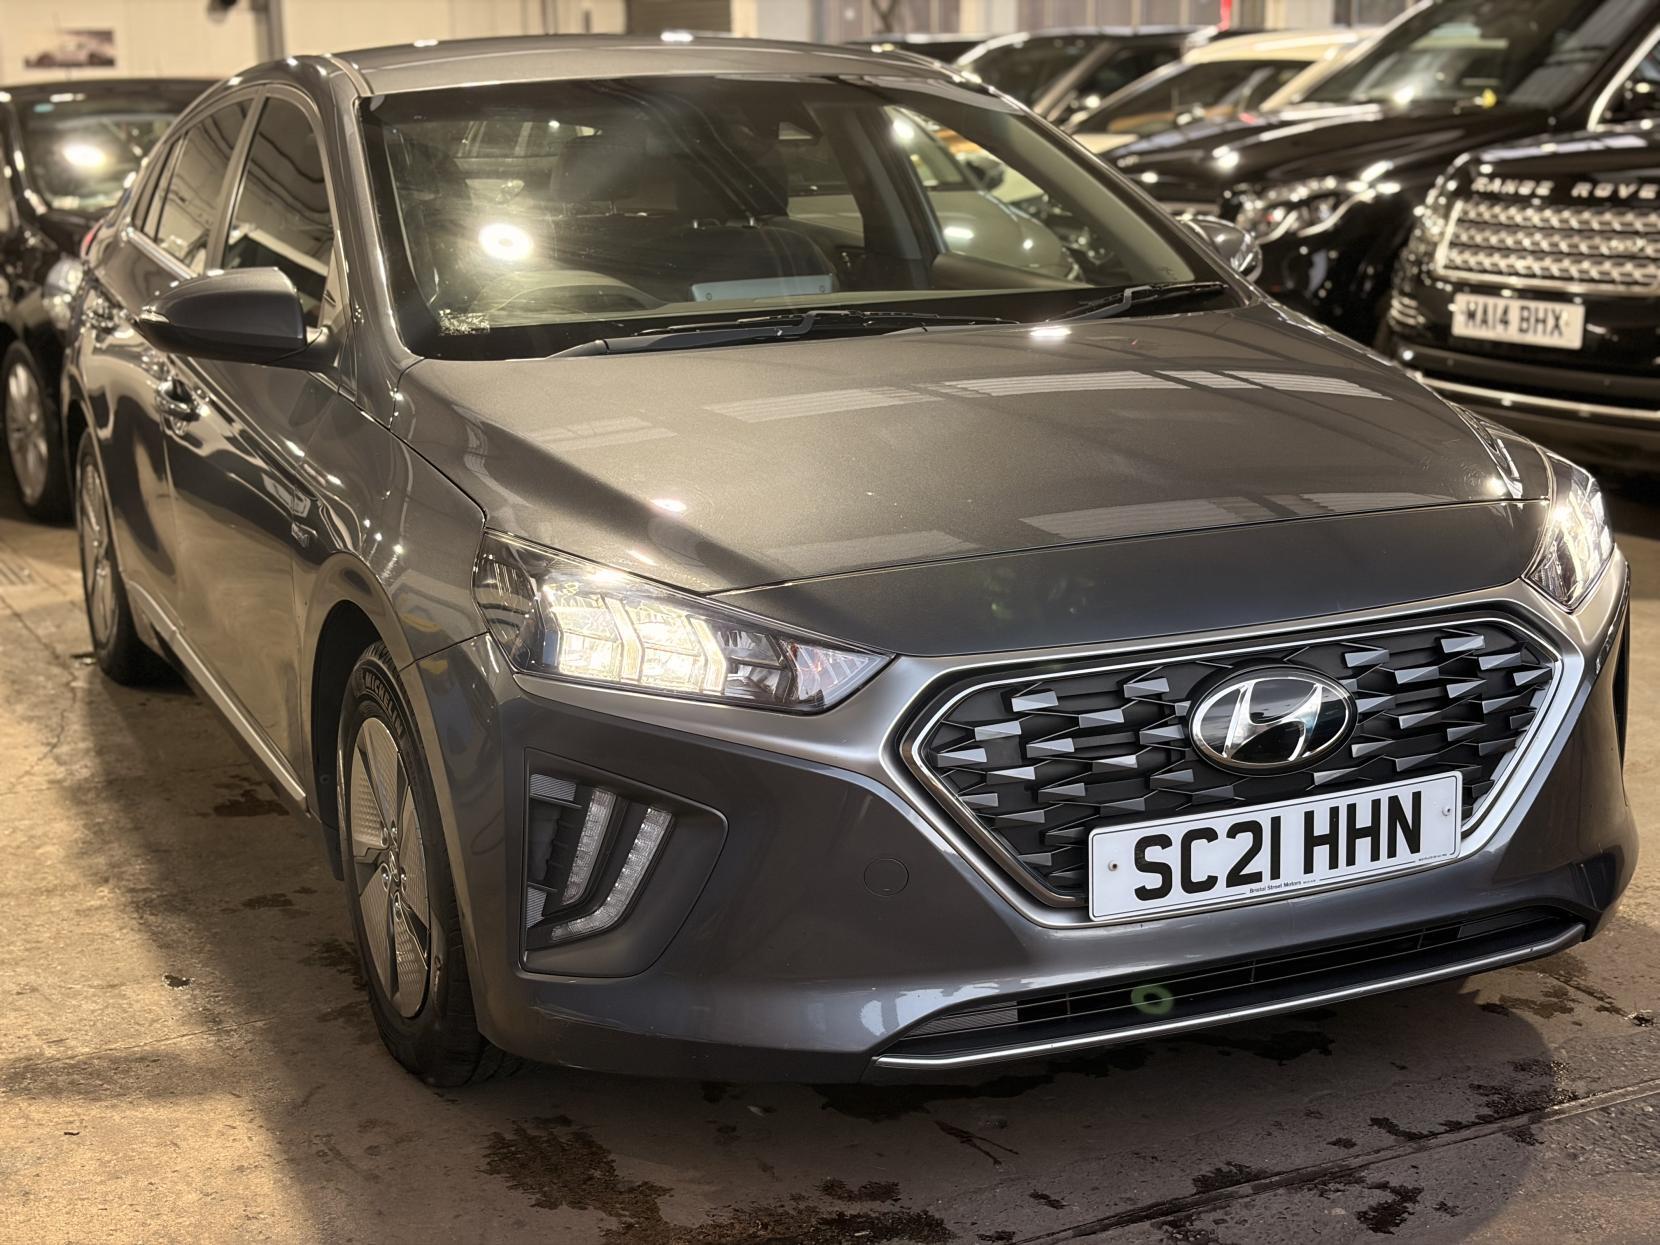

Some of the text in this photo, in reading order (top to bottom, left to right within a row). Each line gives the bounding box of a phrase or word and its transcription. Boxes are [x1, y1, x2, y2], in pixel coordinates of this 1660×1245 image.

[1519, 305, 1563, 337] BHX
[1134, 790, 1422, 902] SC21 HHN
[1249, 886, 1267, 894] Bristol
[1267, 882, 1283, 891] Street
[1283, 879, 1302, 888] Motors
